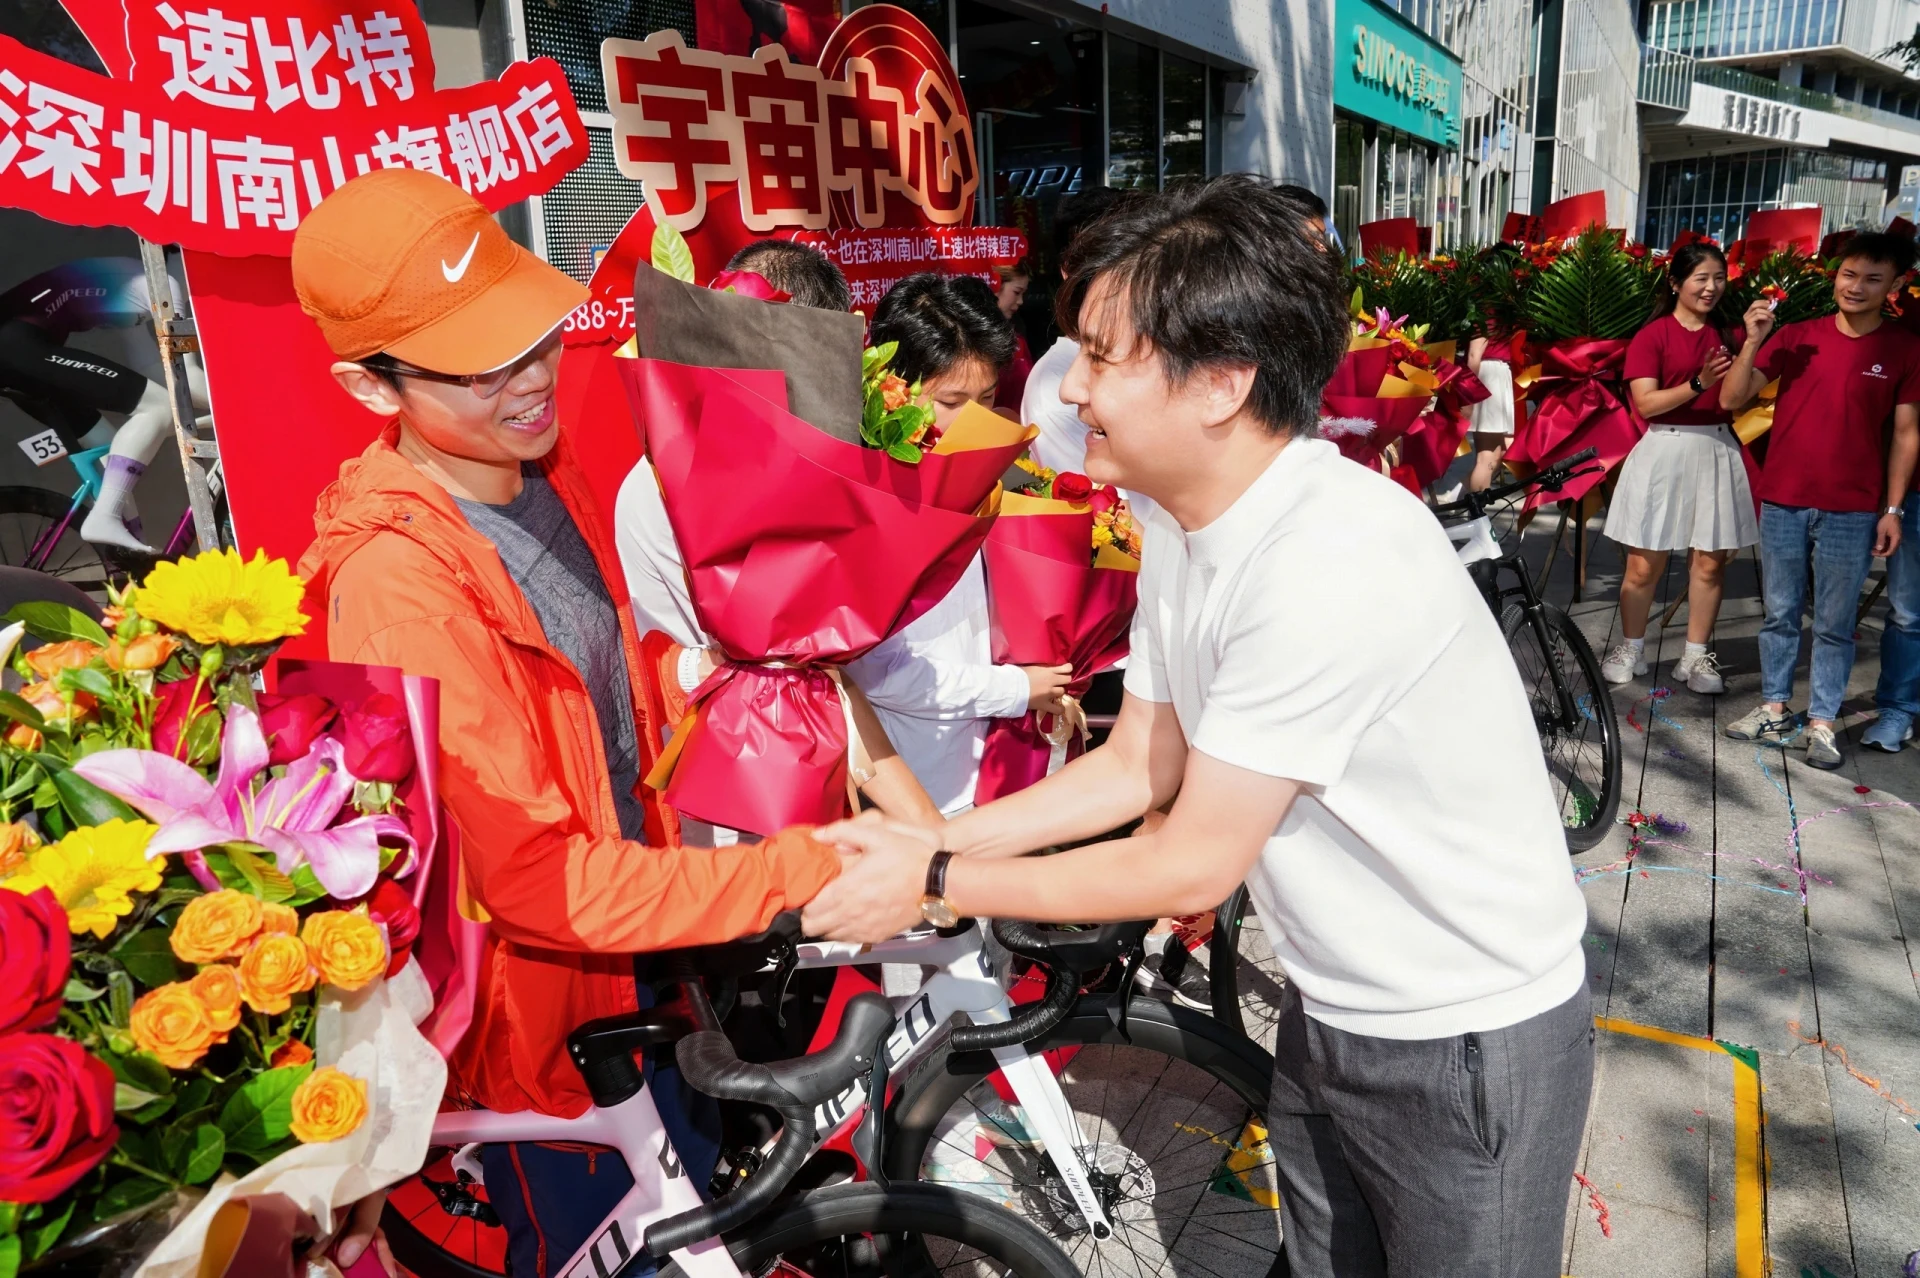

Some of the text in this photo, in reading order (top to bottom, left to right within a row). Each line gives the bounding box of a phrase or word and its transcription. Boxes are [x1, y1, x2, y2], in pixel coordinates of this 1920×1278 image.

[156, 2, 416, 113] 速比特
[615, 45, 974, 216] 宇宙中心
[44, 287, 107, 319] SUNPEED
[45, 354, 119, 379] SUNPEED
